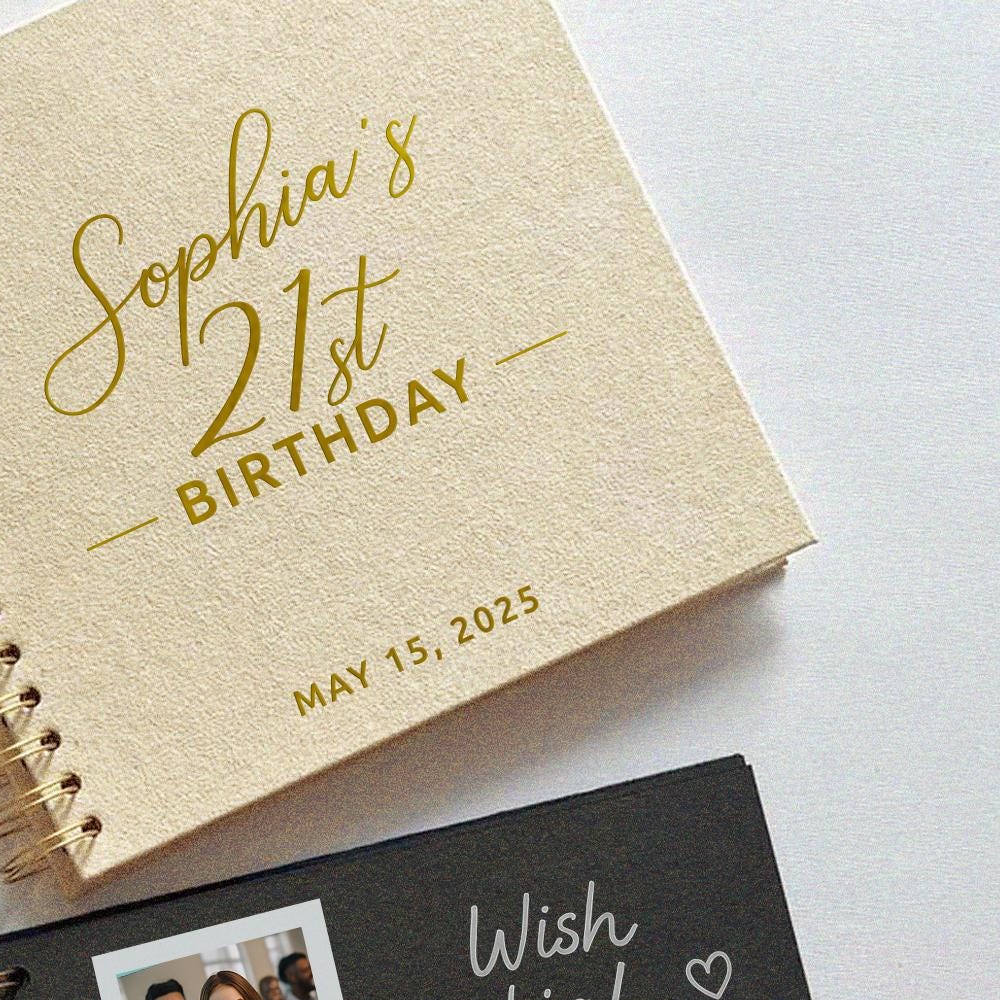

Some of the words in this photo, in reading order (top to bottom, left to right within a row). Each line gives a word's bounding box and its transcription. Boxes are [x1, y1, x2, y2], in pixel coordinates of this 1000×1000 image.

[44, 108, 417, 415] Sophia's
[191, 255, 400, 457] 21st
[175, 357, 471, 525] BIRTHDAY
[293, 660, 371, 716] MAY
[385, 634, 443, 673] 15,
[450, 585, 541, 645] 2025
[469, 880, 638, 977] Wish
